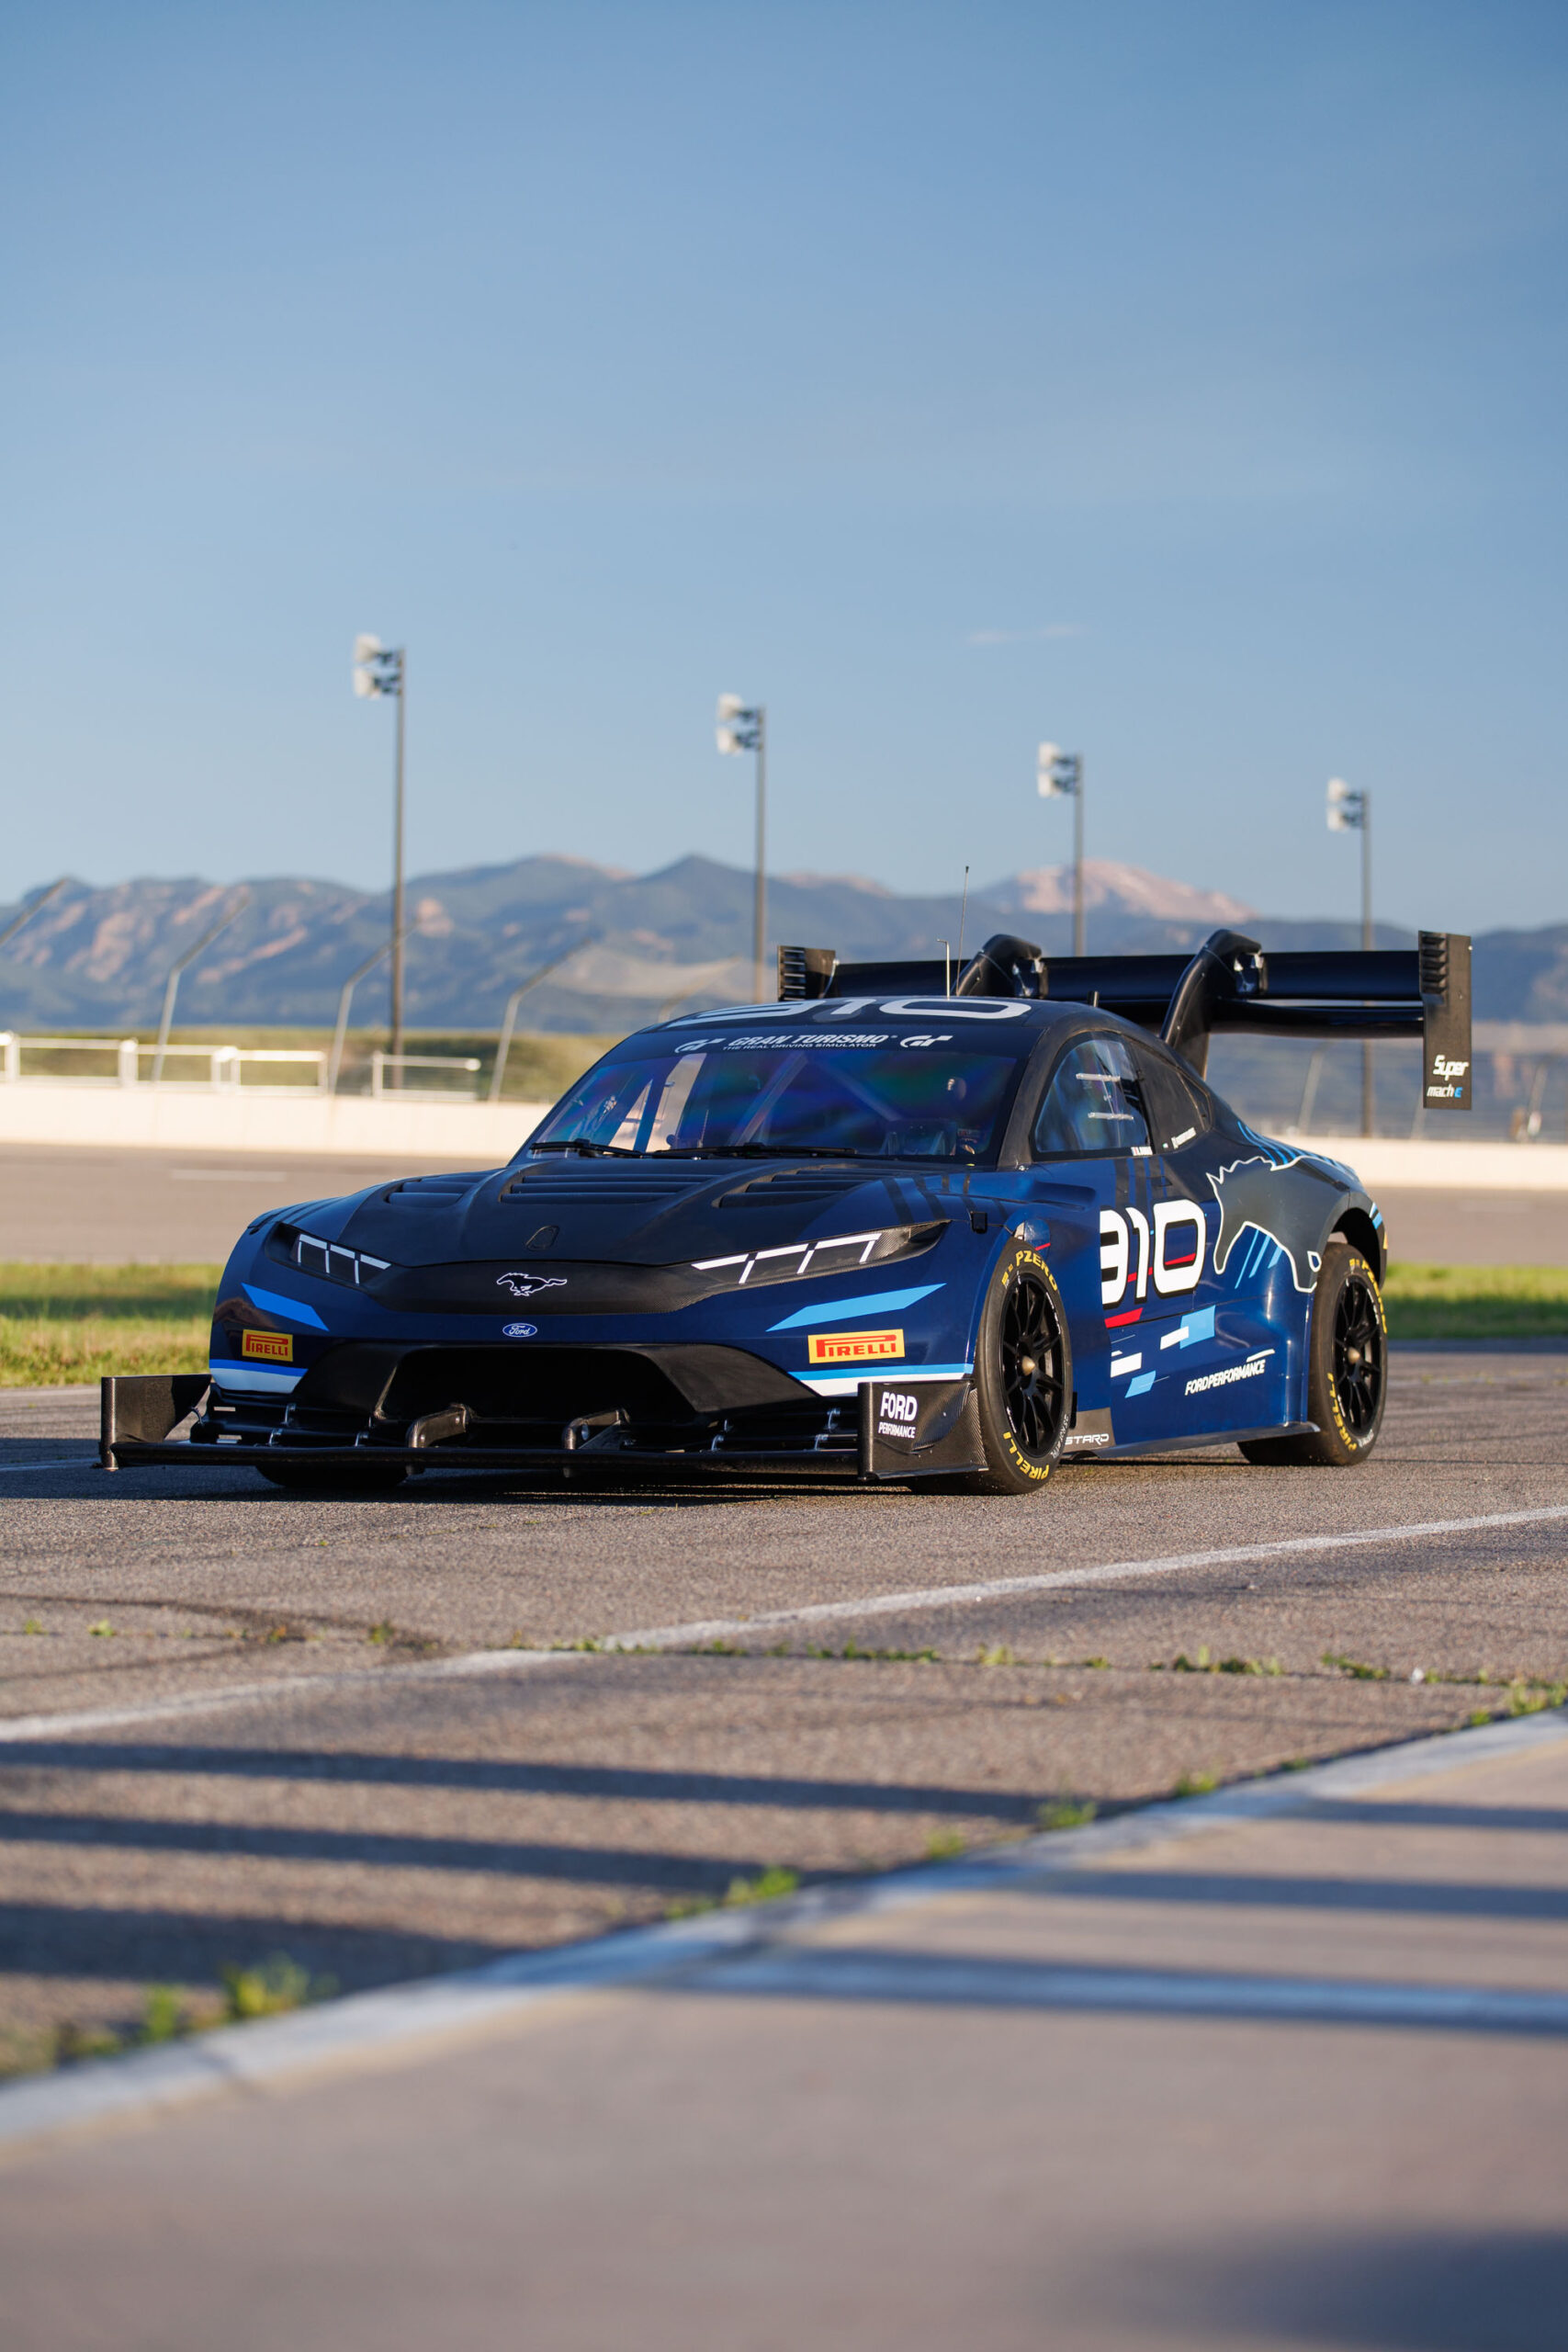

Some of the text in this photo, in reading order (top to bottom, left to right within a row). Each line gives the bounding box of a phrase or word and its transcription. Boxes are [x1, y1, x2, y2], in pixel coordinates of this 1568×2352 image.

[664, 998, 1032, 1029] 310
[728, 1035, 794, 1046] GRAN
[1433, 1054, 1470, 1081] Super
[1100, 1199, 1206, 1306] 310
[508, 1325, 531, 1335] Ford
[245, 1334, 289, 1357] PIRELLI
[816, 1334, 897, 1358] PIRELLI
[880, 1391, 918, 1421] FORD
[877, 1421, 917, 1440] PERFORMANCE
[1064, 1433, 1110, 1445] STARD
[1003, 1430, 1050, 1480] PIRELLI
